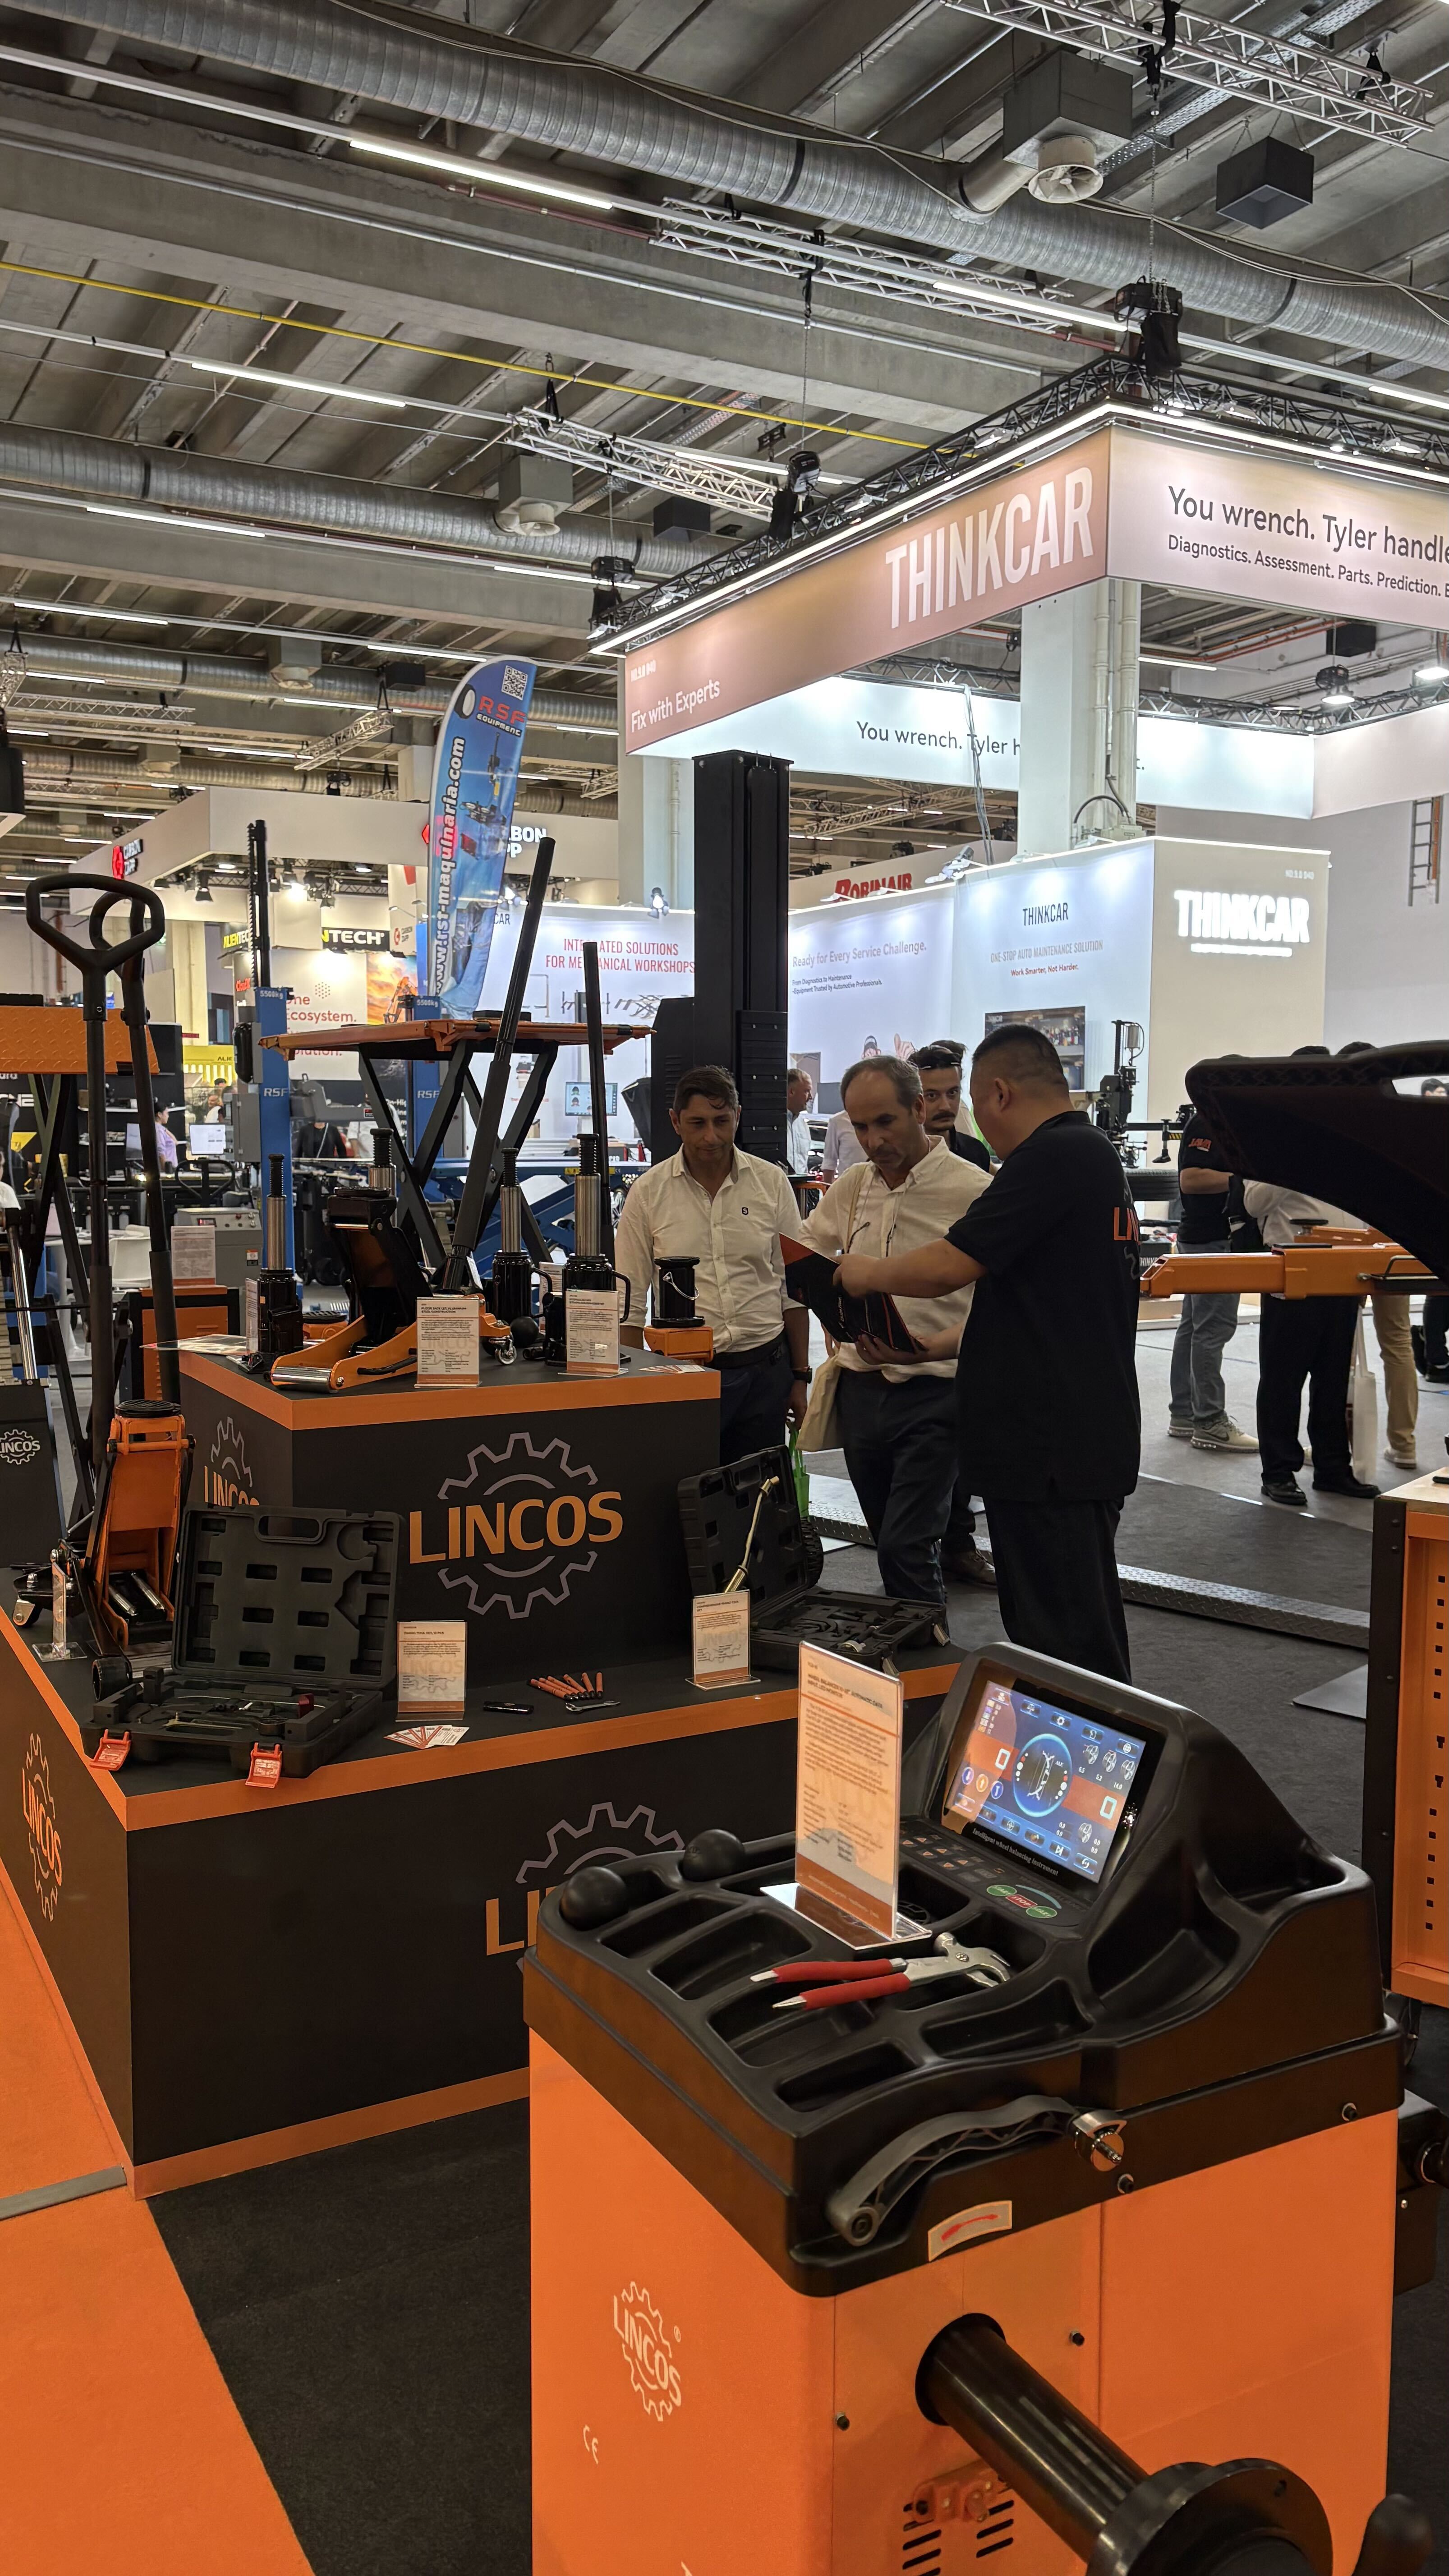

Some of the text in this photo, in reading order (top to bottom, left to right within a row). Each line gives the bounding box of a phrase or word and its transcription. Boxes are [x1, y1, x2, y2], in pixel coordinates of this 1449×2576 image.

[1168, 486, 1213, 521] You
[1223, 504, 1315, 540] wrench.
[1323, 514, 1377, 552] Tyler
[885, 466, 1094, 629] THINKCAR
[1168, 534, 1252, 564] Diagnostics.
[1255, 550, 1334, 579] Assessment.
[1339, 565, 1373, 585] Parts.
[1377, 571, 1442, 597] Prediction.
[478, 696, 526, 724] RSF
[631, 679, 720, 733] Fix with Experts
[857, 721, 889, 742] You
[895, 730, 962, 750] wrench.
[967, 733, 1008, 757] Tyler
[835, 873, 912, 899] ROBINAIR
[1023, 902, 1068, 926] THINKCAR
[1174, 890, 1310, 943] THINKCAR
[564, 939, 679, 956] INTEATED SOLUTIONS
[793, 941, 927, 968] Ready for Every Service Challenge.
[991, 940, 1103, 963] ONE-STOP AUTO MAINTENANCE SOLUTION
[546, 955, 565, 968] FOR
[635, 959, 695, 973] WORKSHOPS
[1025, 966, 1046, 975] Smarter,
[264, 1088, 287, 1097] RSF
[417, 1090, 439, 1099] RSF
[409, 1491, 623, 1564] LINCOS
[995, 1748, 1011, 1770] 0
[1099, 1795, 1117, 1820] 0
[22, 1767, 62, 1887] LINCOS
[972, 1828, 996, 1844] Intelligent
[996, 1840, 1009, 1851] wheel
[1009, 1846, 1032, 1864] balancing
[1012, 1896, 1031, 1907] STOP
[613, 2295, 681, 2407] LINCOS
